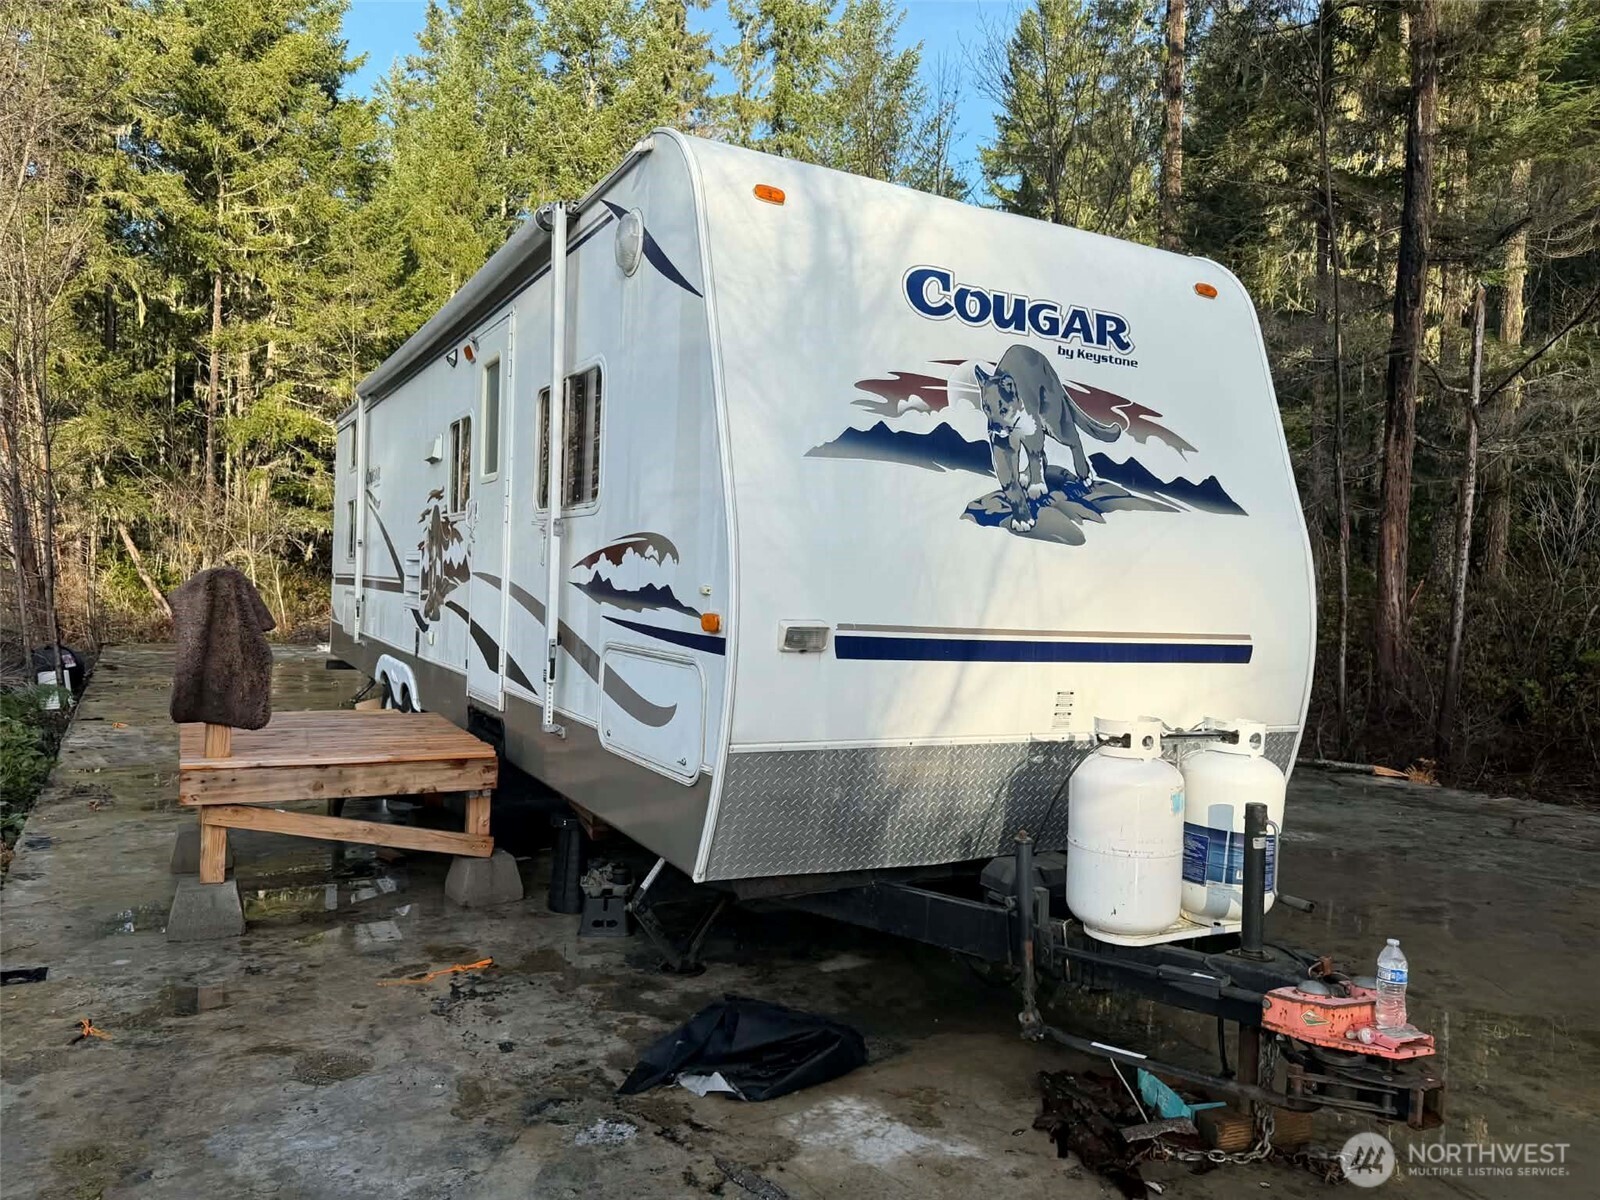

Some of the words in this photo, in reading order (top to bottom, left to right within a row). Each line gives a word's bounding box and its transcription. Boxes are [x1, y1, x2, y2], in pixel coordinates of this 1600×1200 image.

[904, 266, 1132, 353] COUGAR
[1057, 345, 1074, 360] by
[1077, 348, 1139, 369] Keystone
